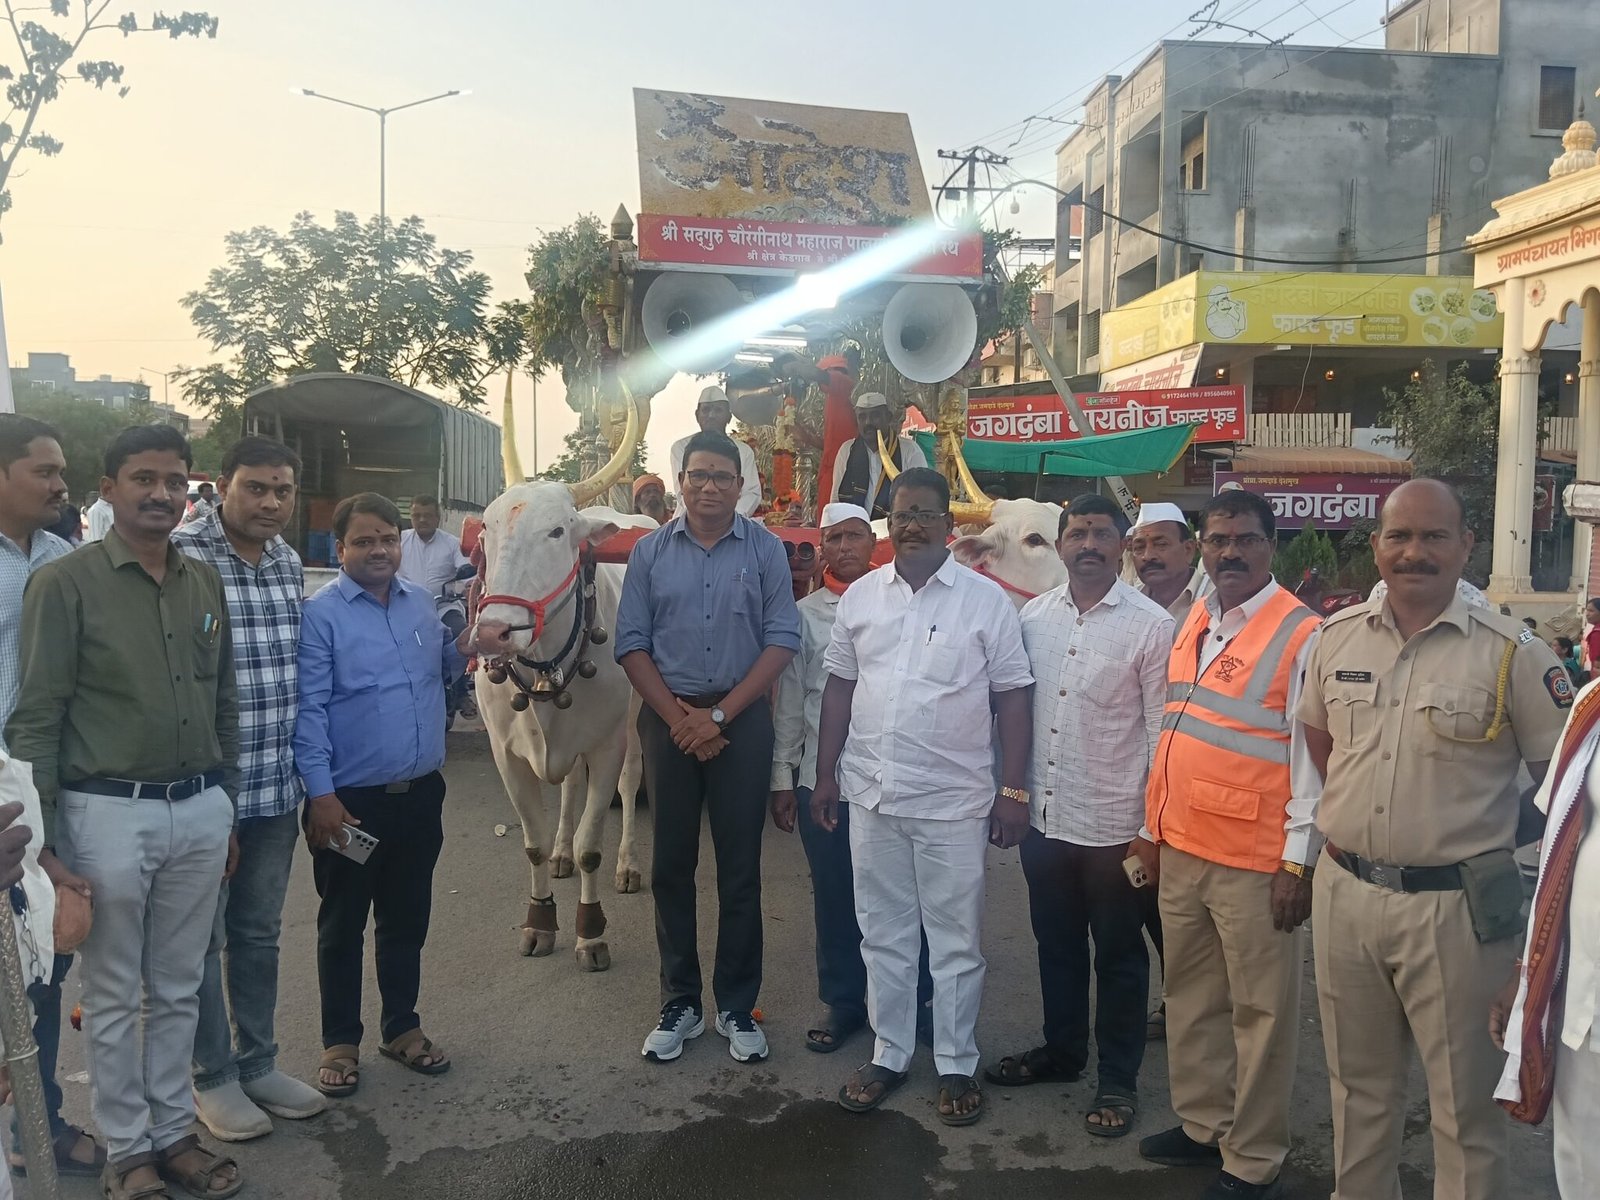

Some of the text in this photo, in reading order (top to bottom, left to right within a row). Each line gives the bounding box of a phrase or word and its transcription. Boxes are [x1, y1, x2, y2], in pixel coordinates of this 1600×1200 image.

[661, 220, 678, 242] श्री
[727, 224, 792, 248] चौरंगीनाथ
[795, 233, 843, 251] महाराज
[1497, 224, 1600, 273] ग्रामपंचायत भिग
[747, 251, 758, 261] श्री
[1272, 313, 1356, 345] फास्ट फूड
[969, 403, 1063, 439] जगदंबा
[1169, 409, 1209, 425] फास्ट
[1211, 407, 1238, 430] फूड
[1264, 483, 1379, 523] जगदंबा
